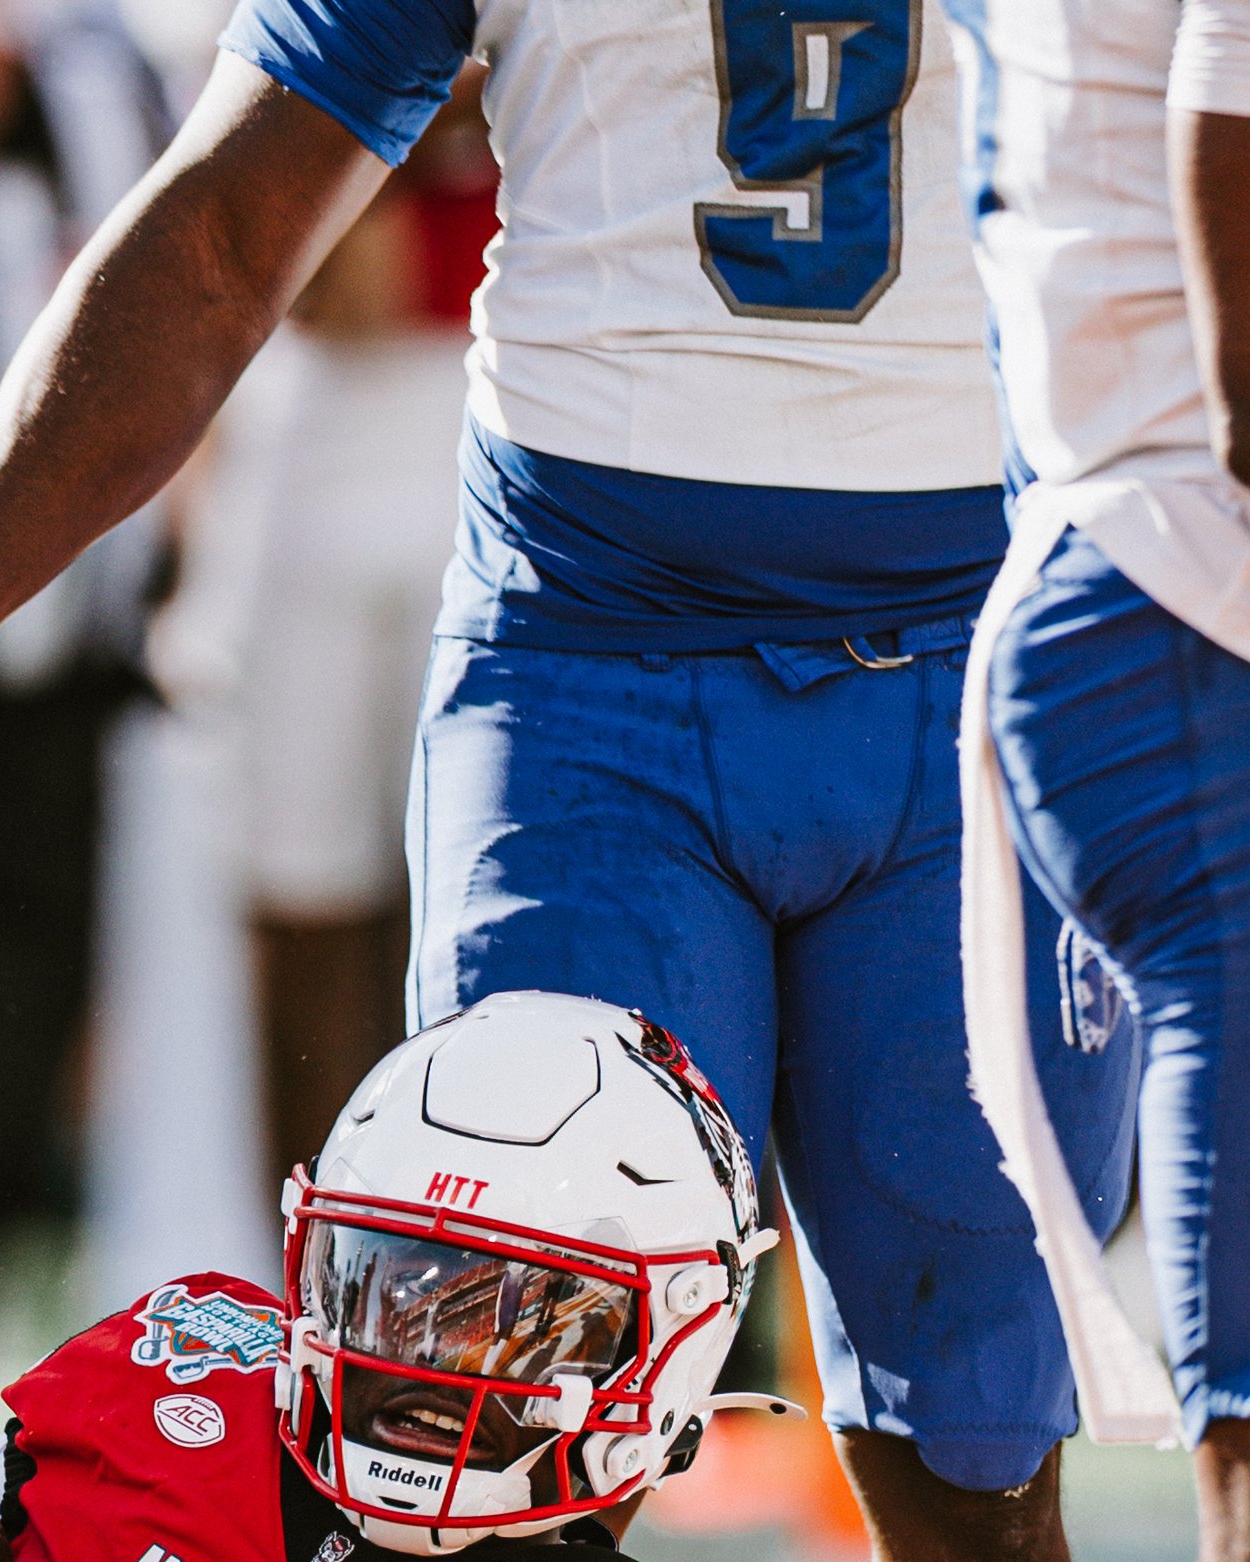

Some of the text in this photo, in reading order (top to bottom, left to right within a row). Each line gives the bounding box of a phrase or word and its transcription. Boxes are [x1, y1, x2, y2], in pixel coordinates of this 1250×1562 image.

[694, 0, 925, 324] 9
[424, 1171, 490, 1210] HTT
[173, 1321, 234, 1353] BOWL
[165, 1405, 218, 1433] ACC
[367, 1460, 443, 1492] Riddell
